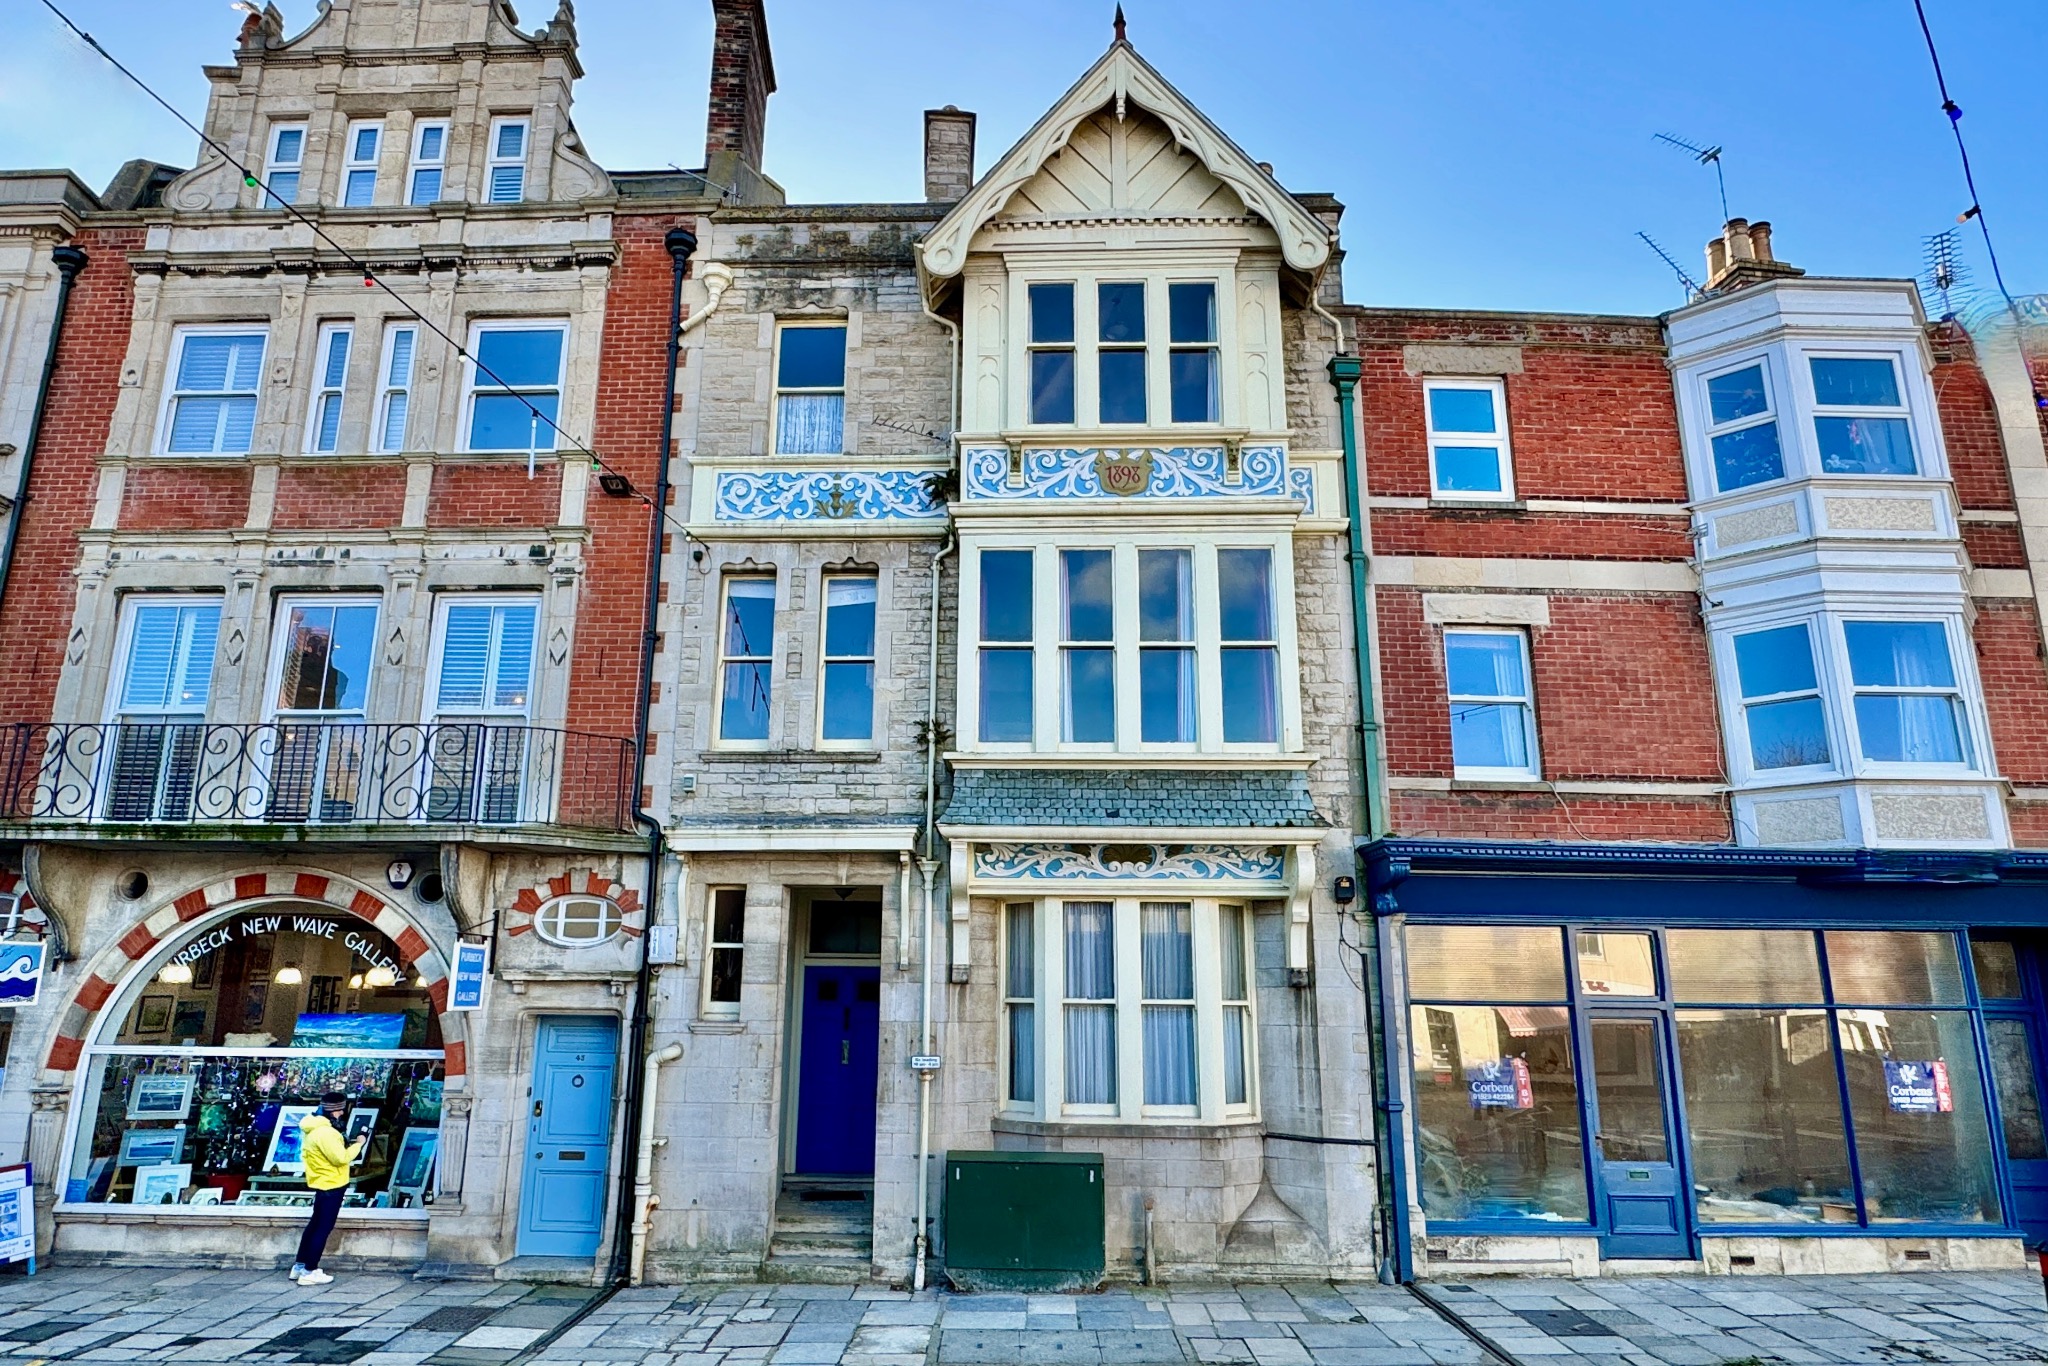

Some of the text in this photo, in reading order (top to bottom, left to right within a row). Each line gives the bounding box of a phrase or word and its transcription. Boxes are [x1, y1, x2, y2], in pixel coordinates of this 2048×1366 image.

[1105, 465, 1141, 489] 1898
[173, 926, 233, 968] RBECK
[242, 916, 281, 937] NEW
[293, 915, 339, 940] WAVE
[457, 991, 478, 1001] GALLERY
[1471, 1081, 1515, 1093] Corbens
[1890, 1085, 1934, 1097] Corbens
